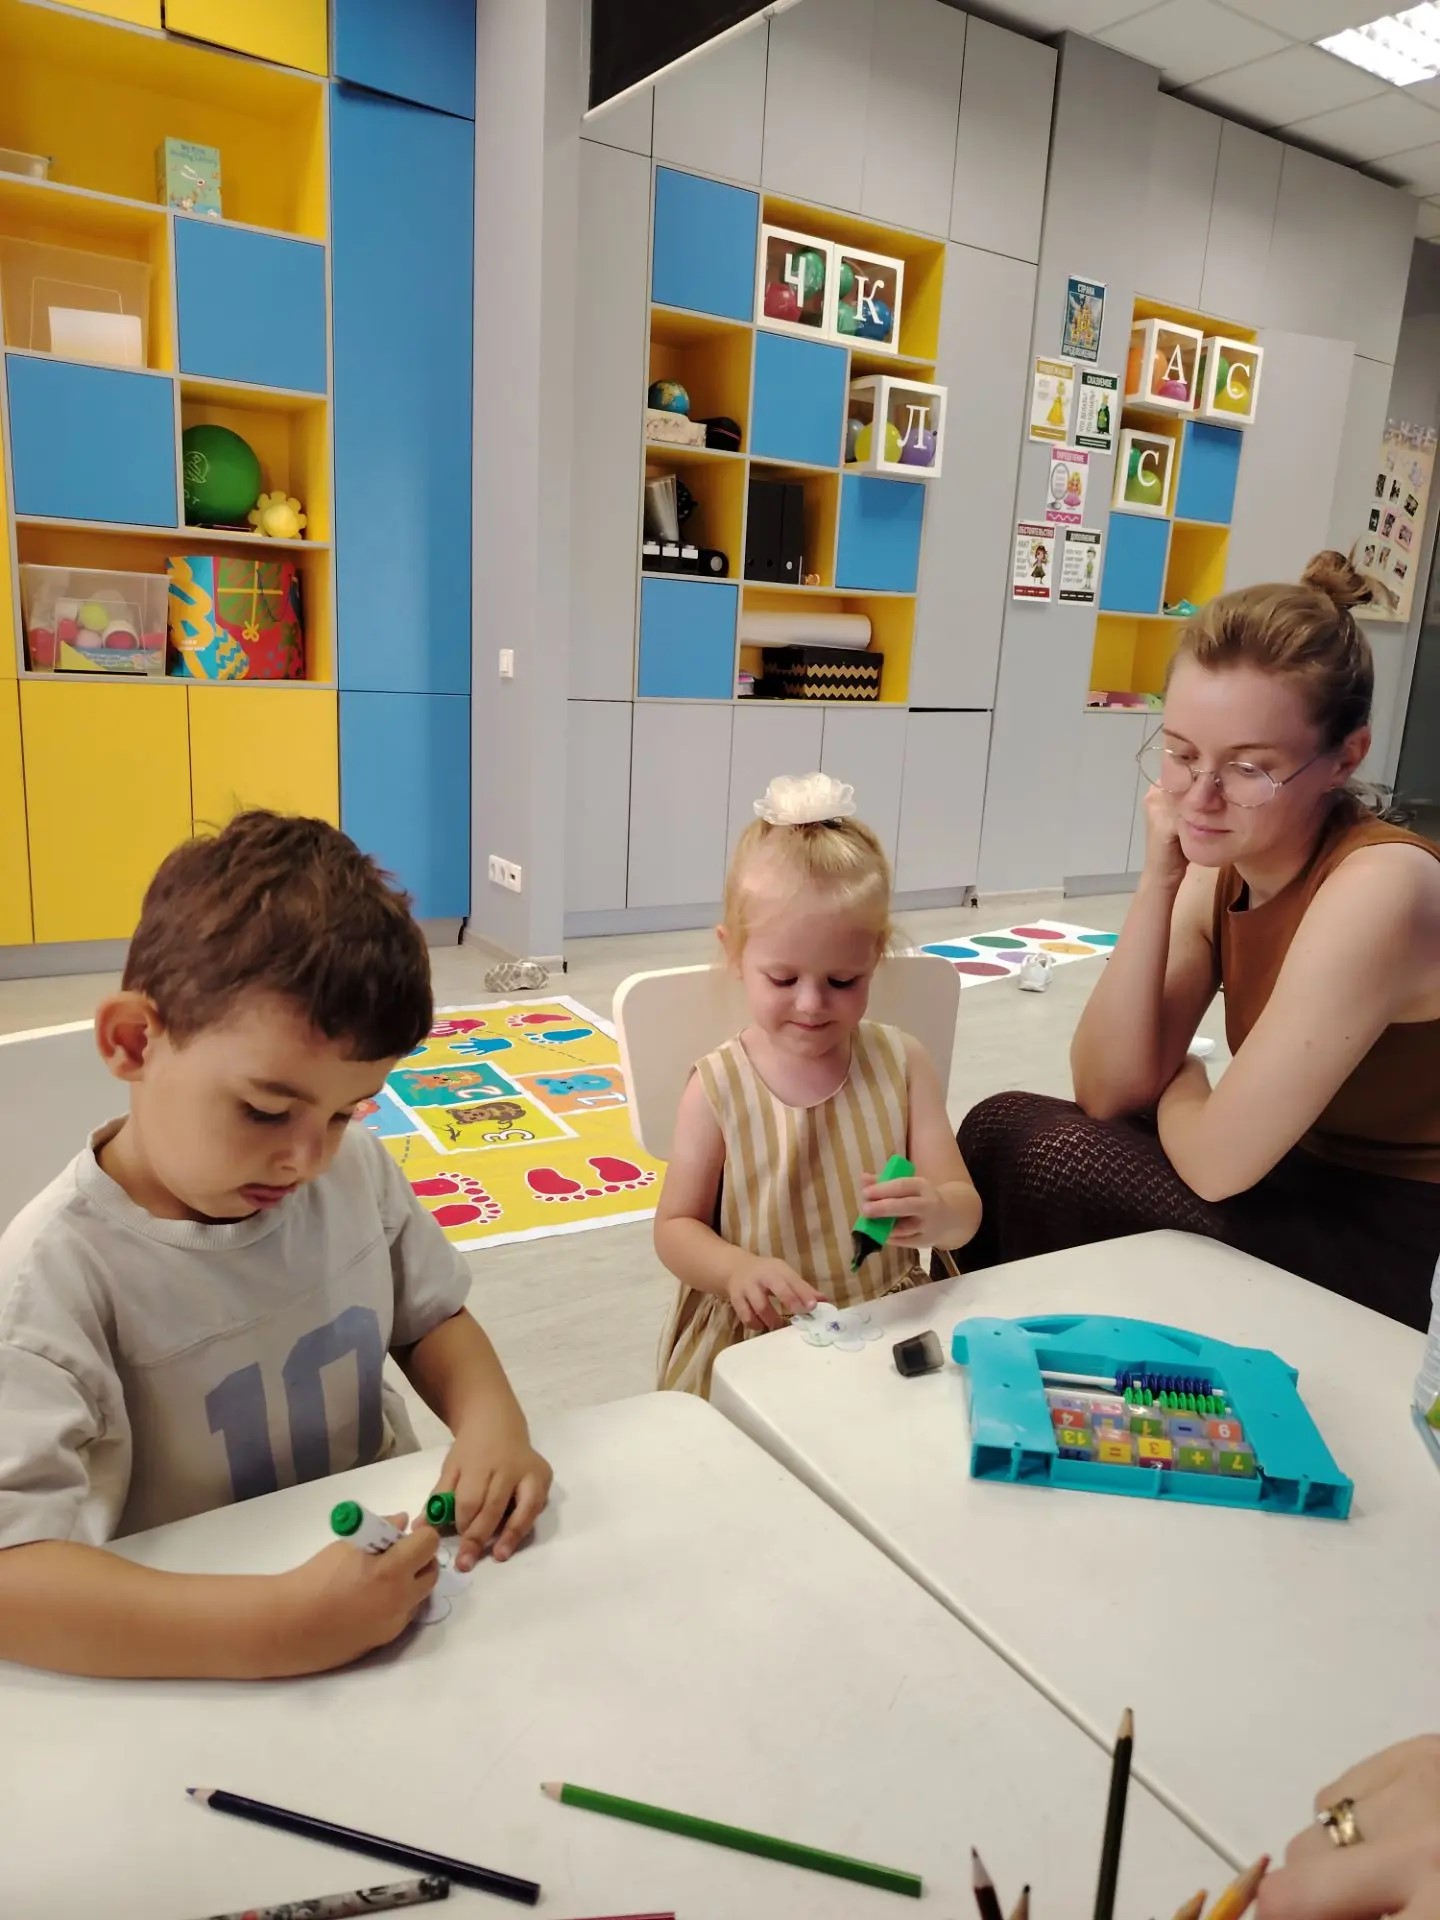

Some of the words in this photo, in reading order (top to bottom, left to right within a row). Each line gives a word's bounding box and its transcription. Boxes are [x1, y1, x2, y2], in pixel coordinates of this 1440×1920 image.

[853, 275, 885, 325] К
[1162, 344, 1187, 385] А
[1226, 363, 1250, 400] С
[897, 404, 930, 449] Л
[1137, 450, 1160, 487] С
[482, 1129, 535, 1143] 3
[205, 1306, 384, 1500] 10
[1063, 1430, 1086, 1445] 13
